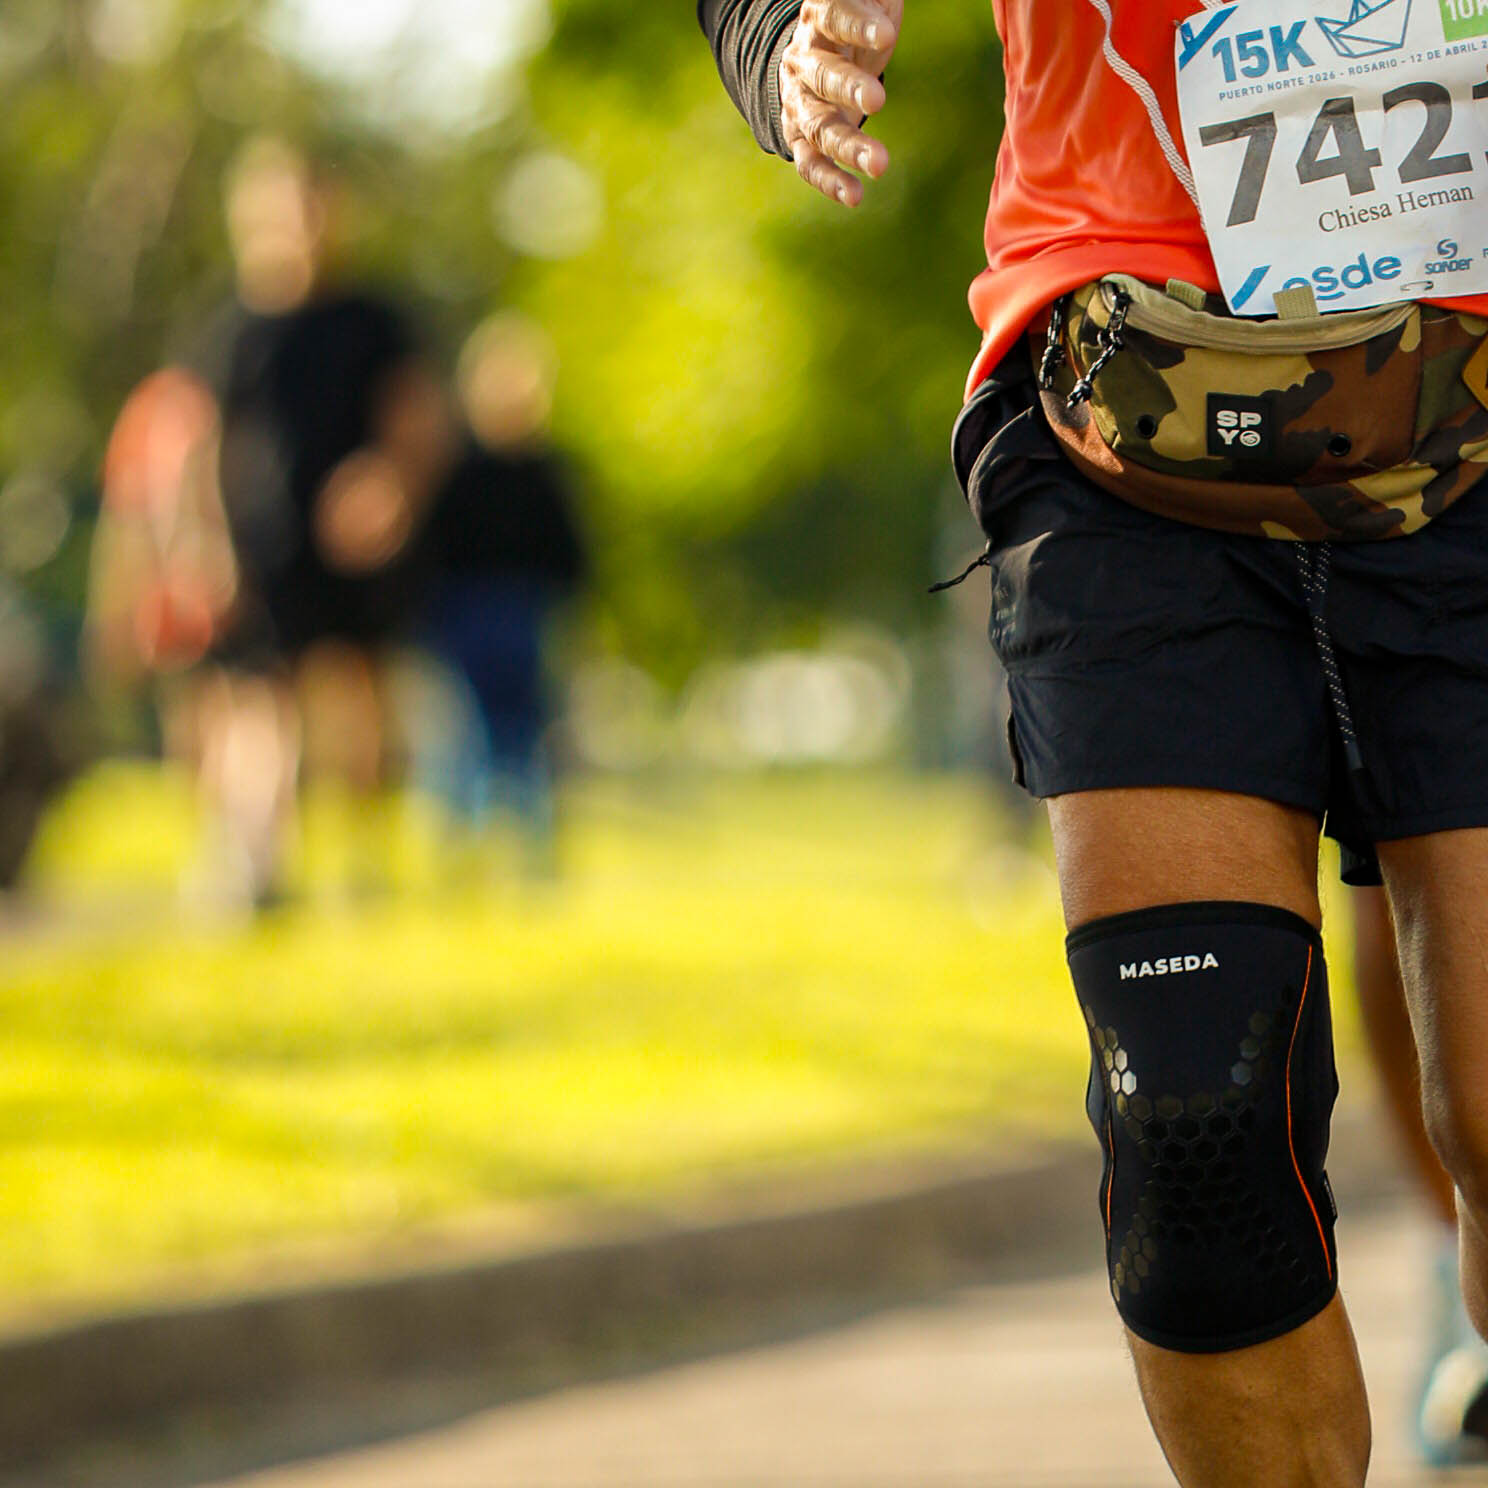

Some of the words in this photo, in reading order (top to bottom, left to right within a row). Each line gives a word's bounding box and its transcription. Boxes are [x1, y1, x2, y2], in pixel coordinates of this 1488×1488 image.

[1212, 20, 1316, 83] 15K
[1219, 85, 1263, 100] PUERTO
[1267, 77, 1304, 92] NORTE
[1308, 71, 1336, 84] 2026
[1348, 60, 1397, 76] ROSARIO
[1410, 53, 1422, 63] 12
[1427, 50, 1441, 60] DE
[1445, 44, 1477, 57] ABRIL
[1318, 202, 1392, 232] Chiesa
[1396, 185, 1475, 213] Hernan
[1120, 952, 1219, 981] MASEDA
